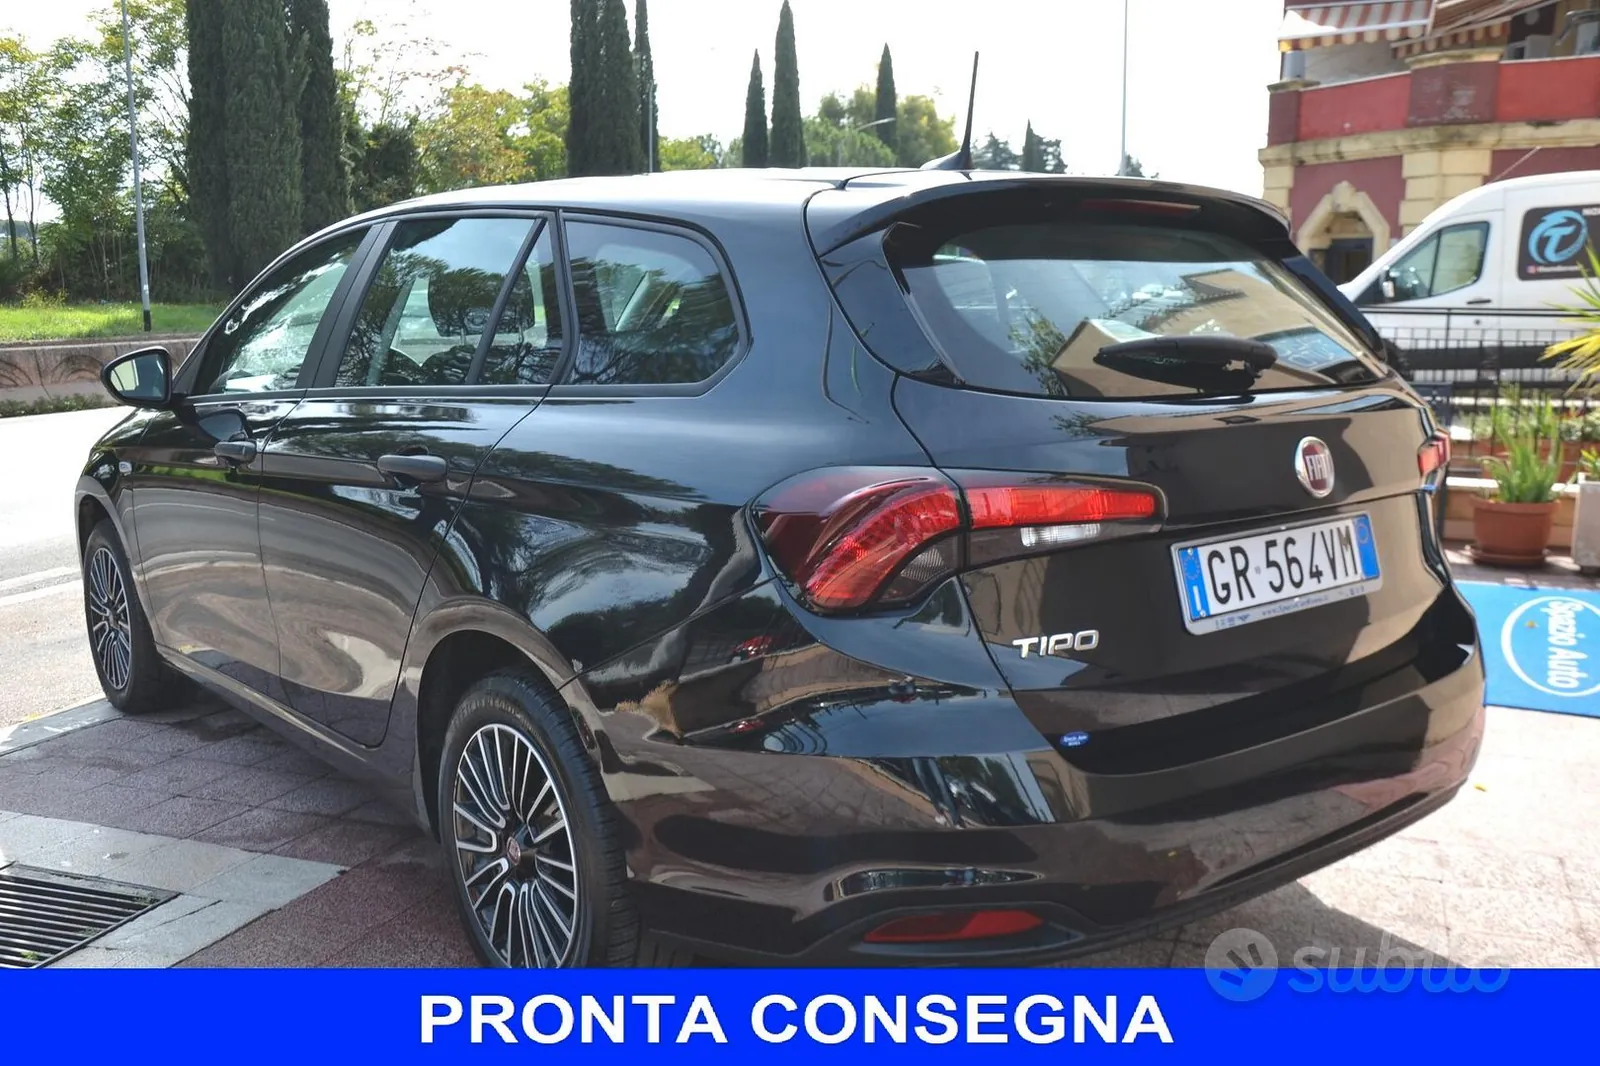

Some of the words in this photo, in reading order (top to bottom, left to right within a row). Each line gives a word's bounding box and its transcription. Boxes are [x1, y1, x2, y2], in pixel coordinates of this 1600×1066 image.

[1304, 452, 1334, 481] FIAT
[1207, 546, 1256, 605] GR
[1264, 525, 1359, 594] 564VM
[1012, 629, 1100, 659] TIPO
[1540, 601, 1587, 646] Spazio
[1546, 646, 1589, 688] Auto
